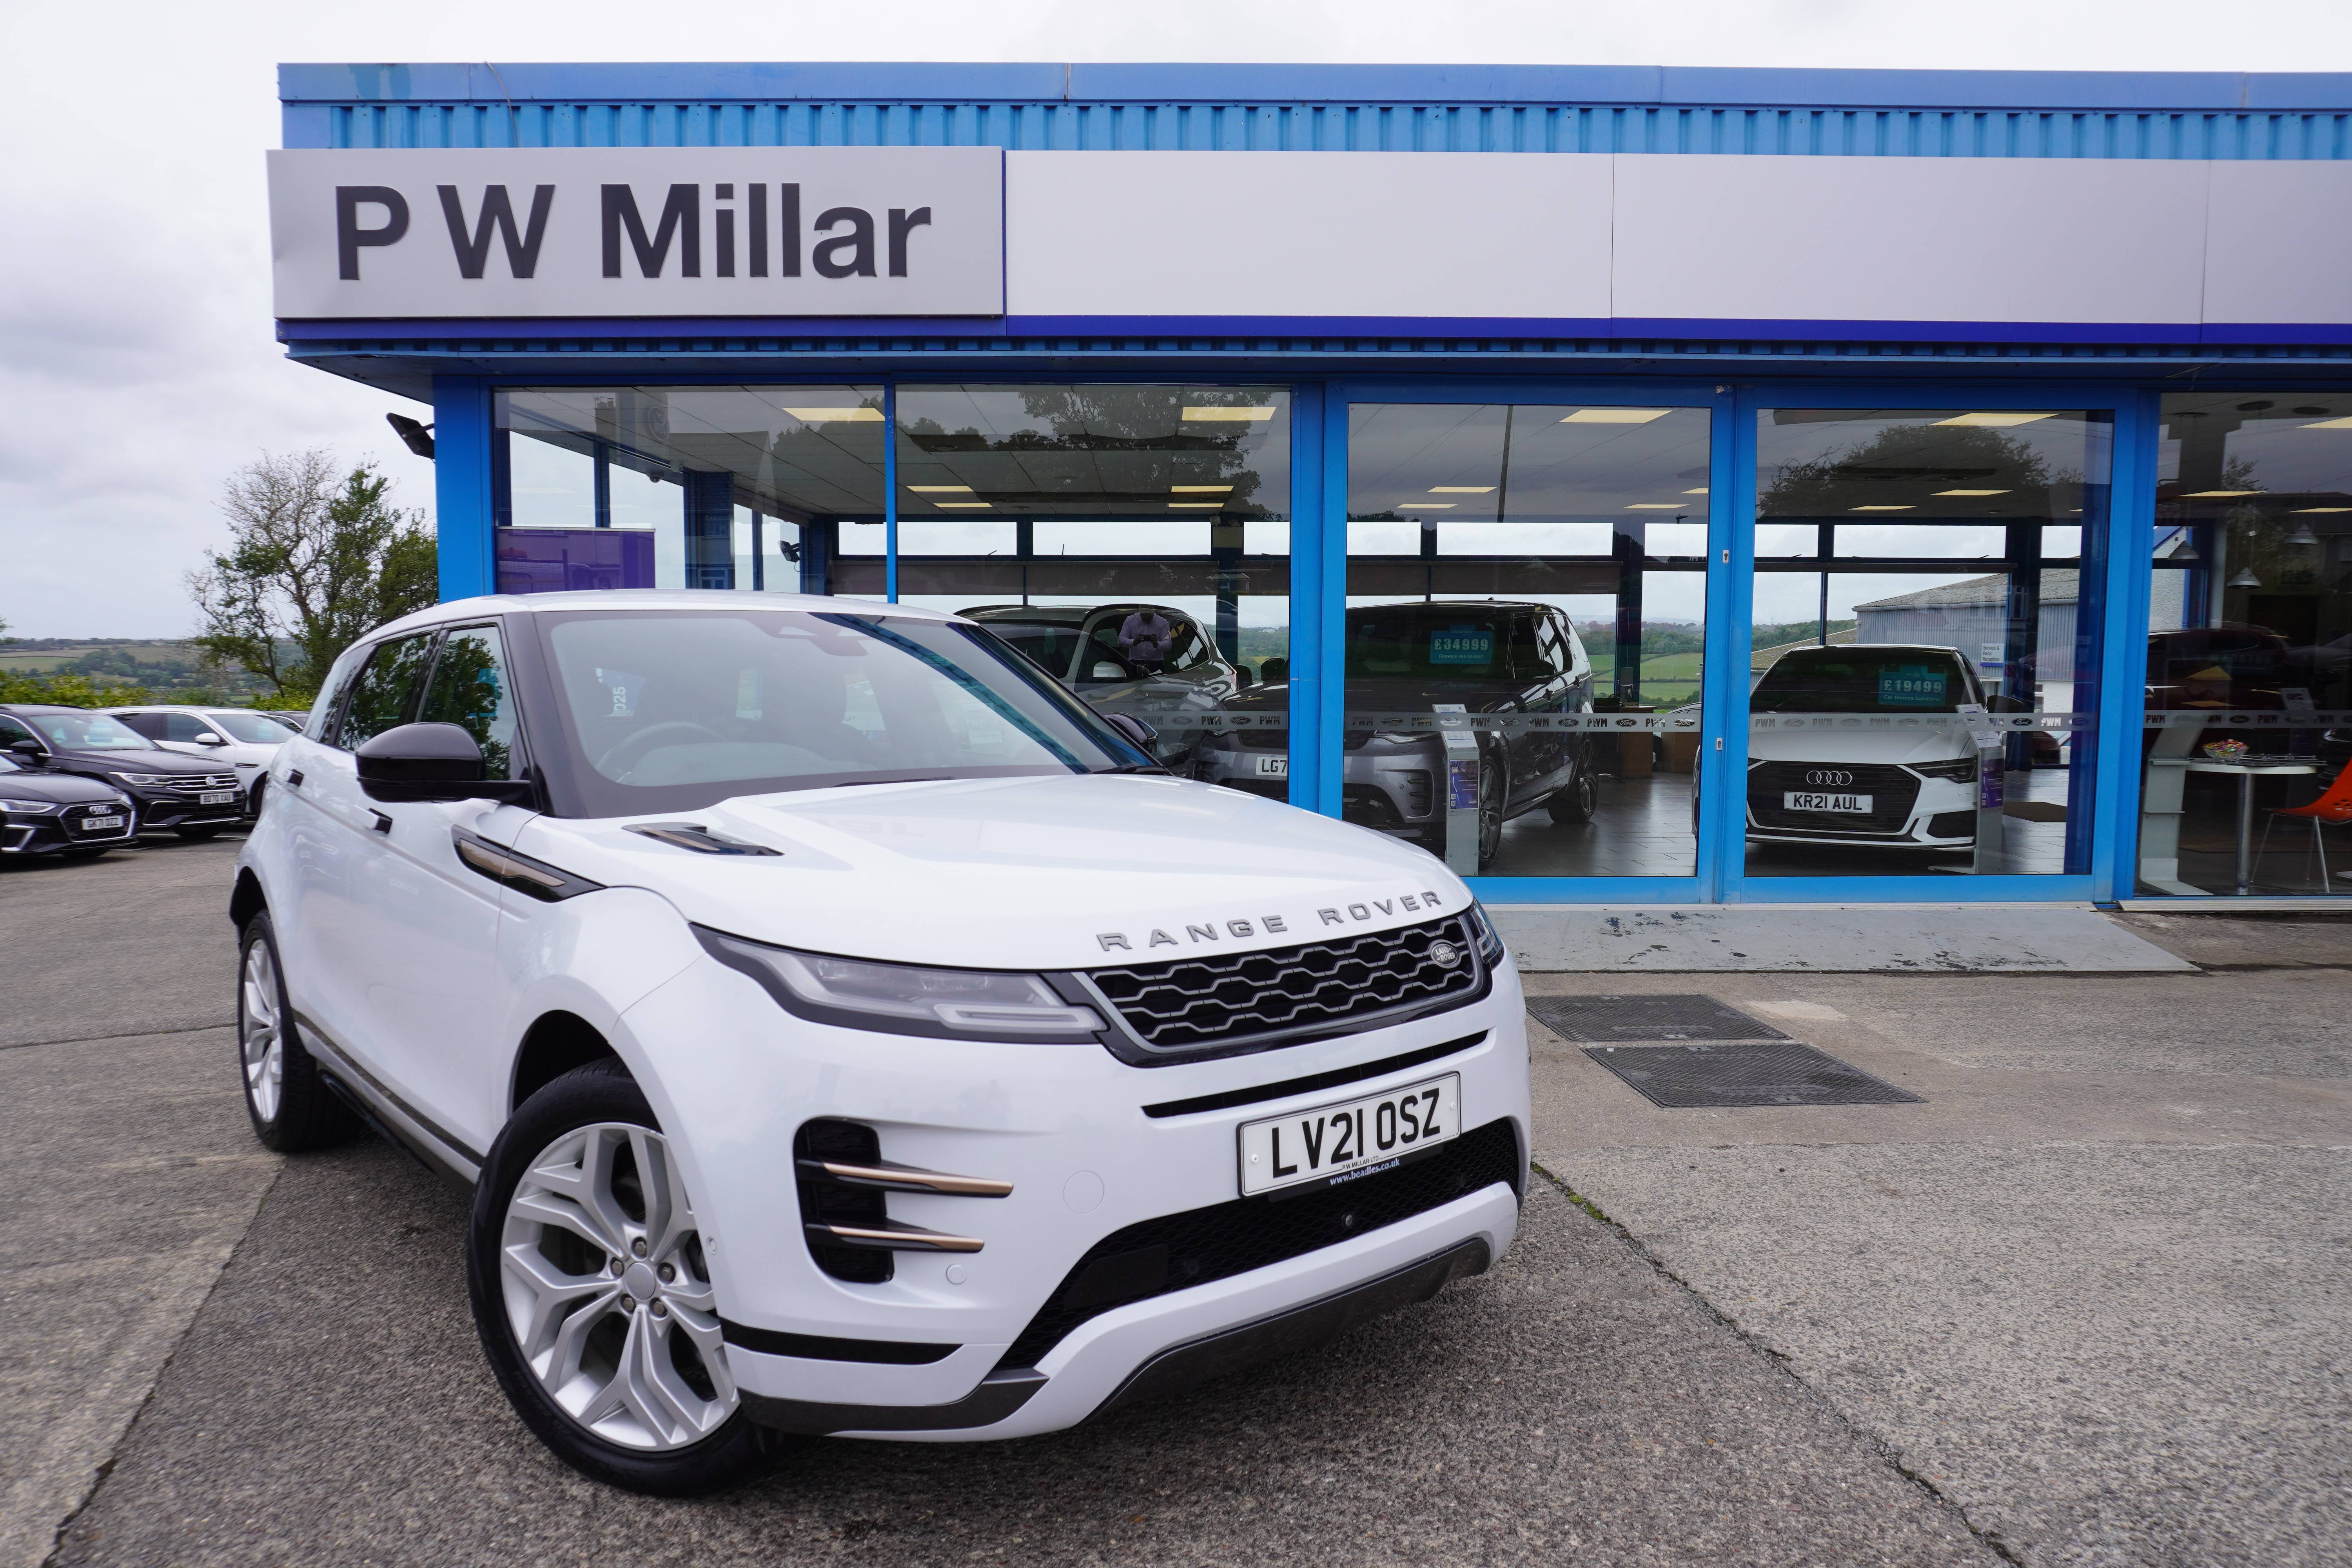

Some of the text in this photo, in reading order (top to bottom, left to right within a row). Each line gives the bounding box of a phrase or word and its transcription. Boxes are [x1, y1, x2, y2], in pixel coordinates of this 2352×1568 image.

[335, 182, 932, 281] P W Millar
[1434, 638, 1488, 651] £34999
[1884, 679, 1942, 693] £19499
[1201, 716, 1222, 725] PWM
[1259, 716, 1280, 725] PWM
[1470, 717, 1491, 727] PWM
[1529, 718, 1549, 727] PWM
[1587, 718, 1607, 727] PWM
[1755, 718, 1775, 727] PWM
[1812, 718, 1833, 727] PWM
[2041, 717, 2061, 726] PWM
[2146, 715, 2165, 724] PWM
[1794, 794, 1862, 810] KR21 AUL
[1096, 891, 1442, 951] RANGE ROVER
[1435, 946, 1450, 956] LAND
[1440, 952, 1456, 962] ROVER
[1272, 1087, 1440, 1178] LV21 OSZ
[1330, 1158, 1400, 1185] www.beadles.co.uk
